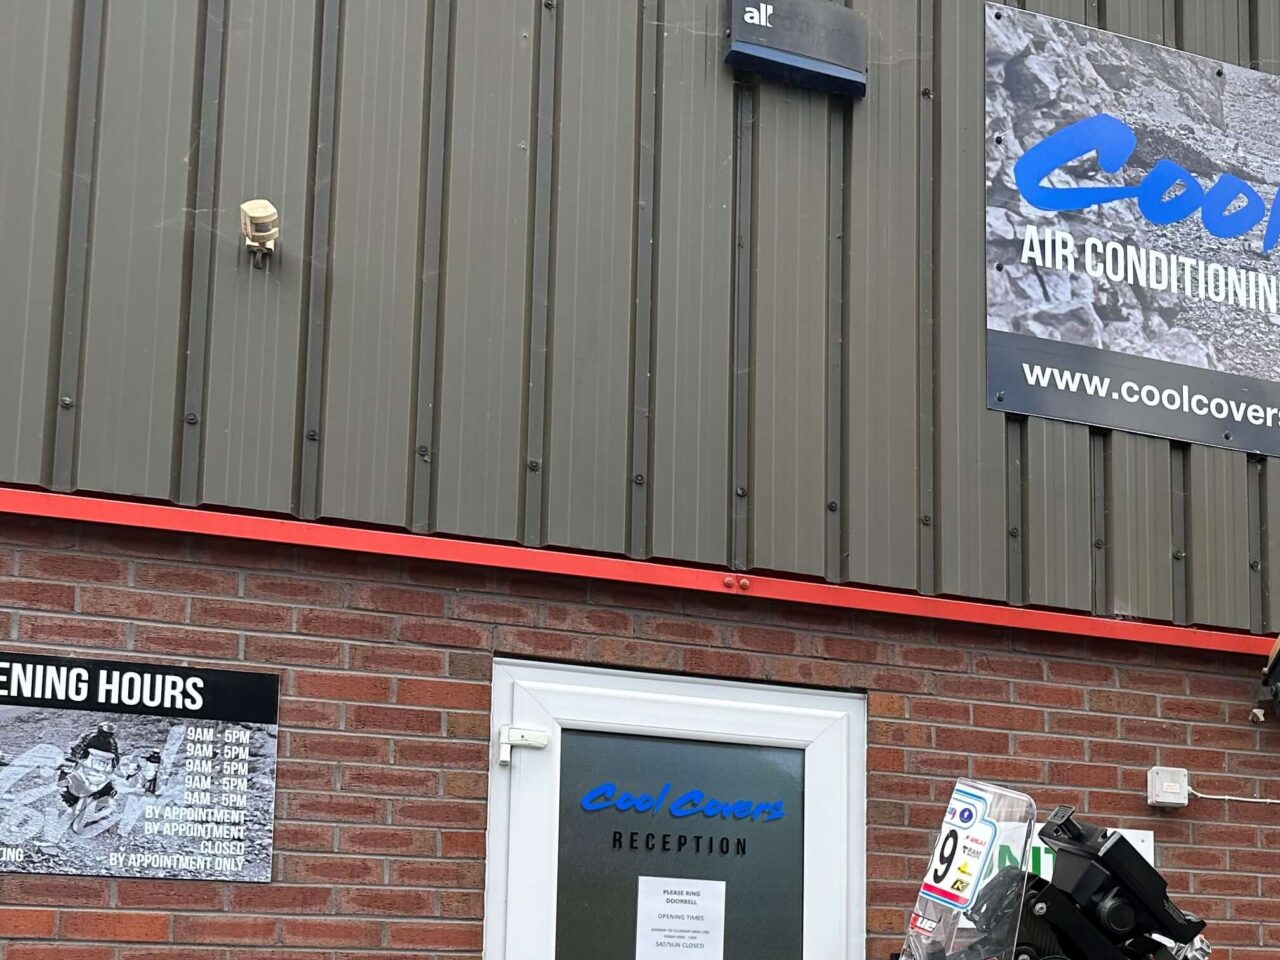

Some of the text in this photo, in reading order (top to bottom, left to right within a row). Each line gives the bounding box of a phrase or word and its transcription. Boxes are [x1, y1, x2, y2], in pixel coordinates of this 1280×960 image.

[1020, 224, 1077, 273] AIR
[98, 670, 204, 711] HOURS
[187, 727, 213, 741] 9AM
[225, 730, 250, 744] 5PM
[186, 743, 213, 757] 9AM
[224, 746, 249, 759] 5PM
[186, 759, 212, 773] 9AM
[223, 762, 248, 775] 5PM
[185, 775, 211, 789] 9AM
[222, 777, 247, 791] 5PM
[184, 791, 210, 805] 9AM
[221, 794, 247, 807] 5PM
[581, 782, 785, 822] Cool Covers
[145, 805, 246, 824] BY APPOINTMENT
[144, 822, 246, 839] BY APPOINTMENT
[200, 841, 244, 855] CLOSED
[612, 831, 747, 855] RECEPTION
[109, 852, 244, 872] BY APPOINTMENT ONLY
